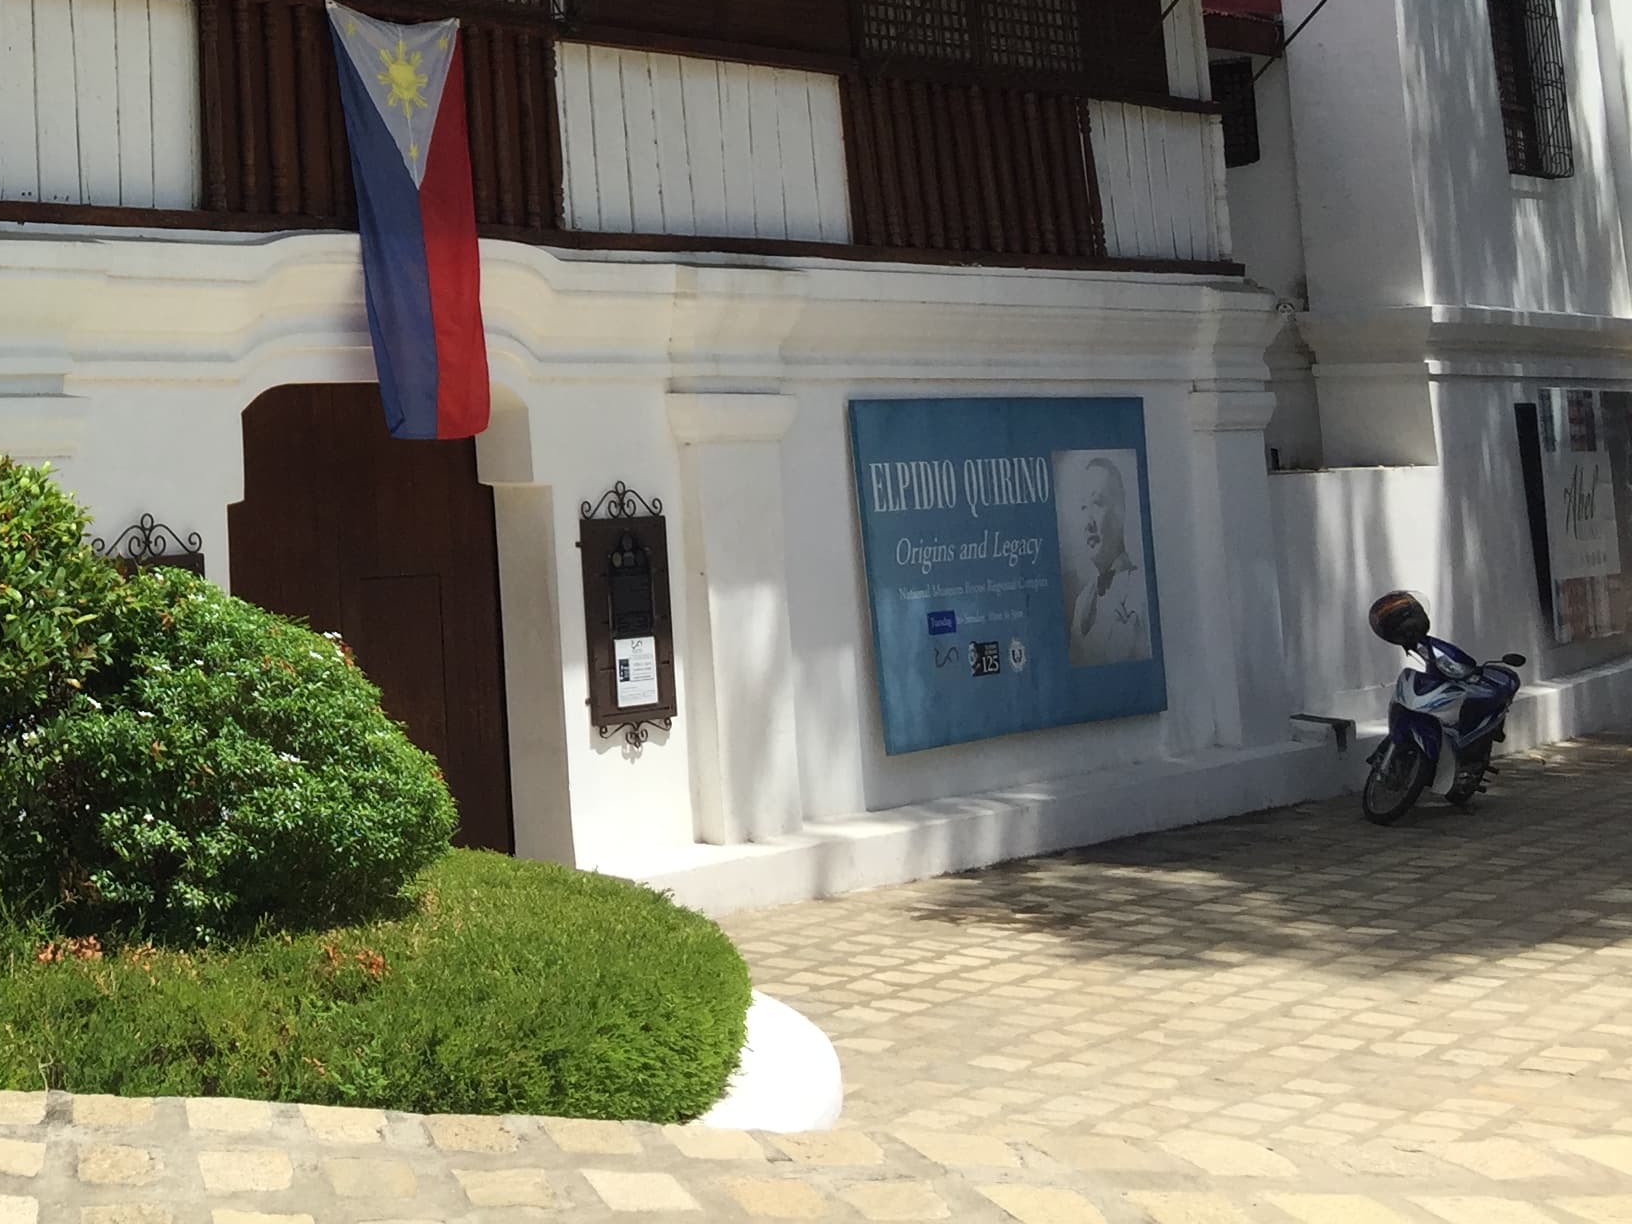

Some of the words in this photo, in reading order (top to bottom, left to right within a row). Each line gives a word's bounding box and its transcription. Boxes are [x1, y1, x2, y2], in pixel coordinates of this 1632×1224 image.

[869, 459, 957, 513] ELPIDIO
[963, 456, 1050, 518] QUIRINO
[896, 536, 955, 575] Origins
[959, 530, 987, 560] and
[992, 531, 1043, 568] Legacy
[982, 655, 999, 673] 125
